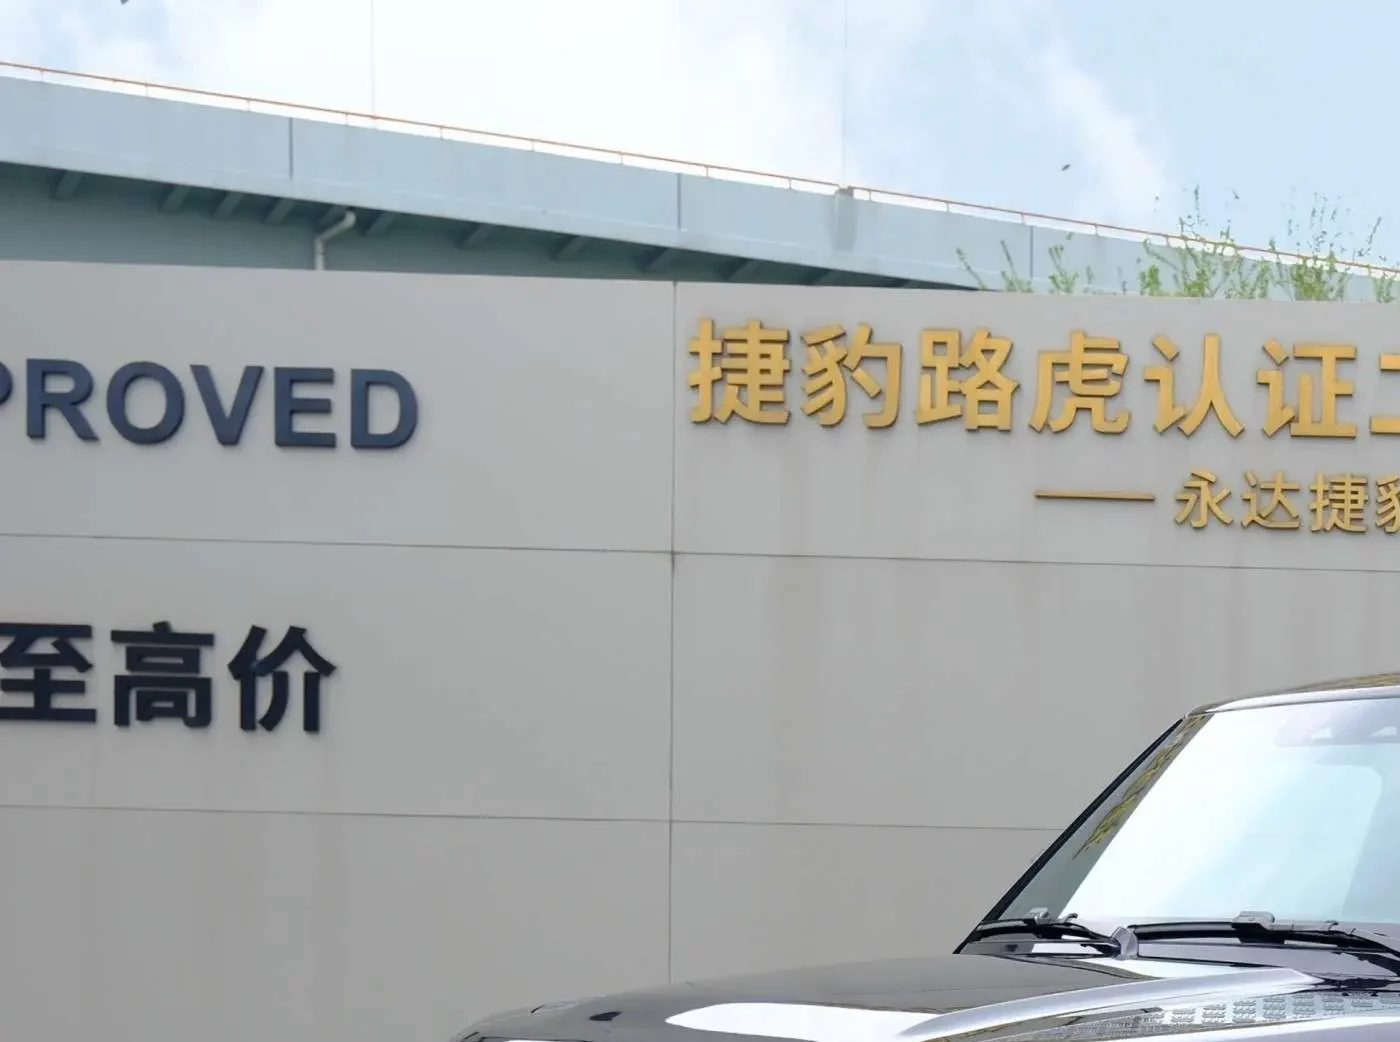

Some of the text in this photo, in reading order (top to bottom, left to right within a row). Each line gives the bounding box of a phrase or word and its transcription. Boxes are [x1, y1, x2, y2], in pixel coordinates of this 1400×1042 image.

[0, 358, 418, 451] ROVED
[0, 620, 338, 735] 至高价
